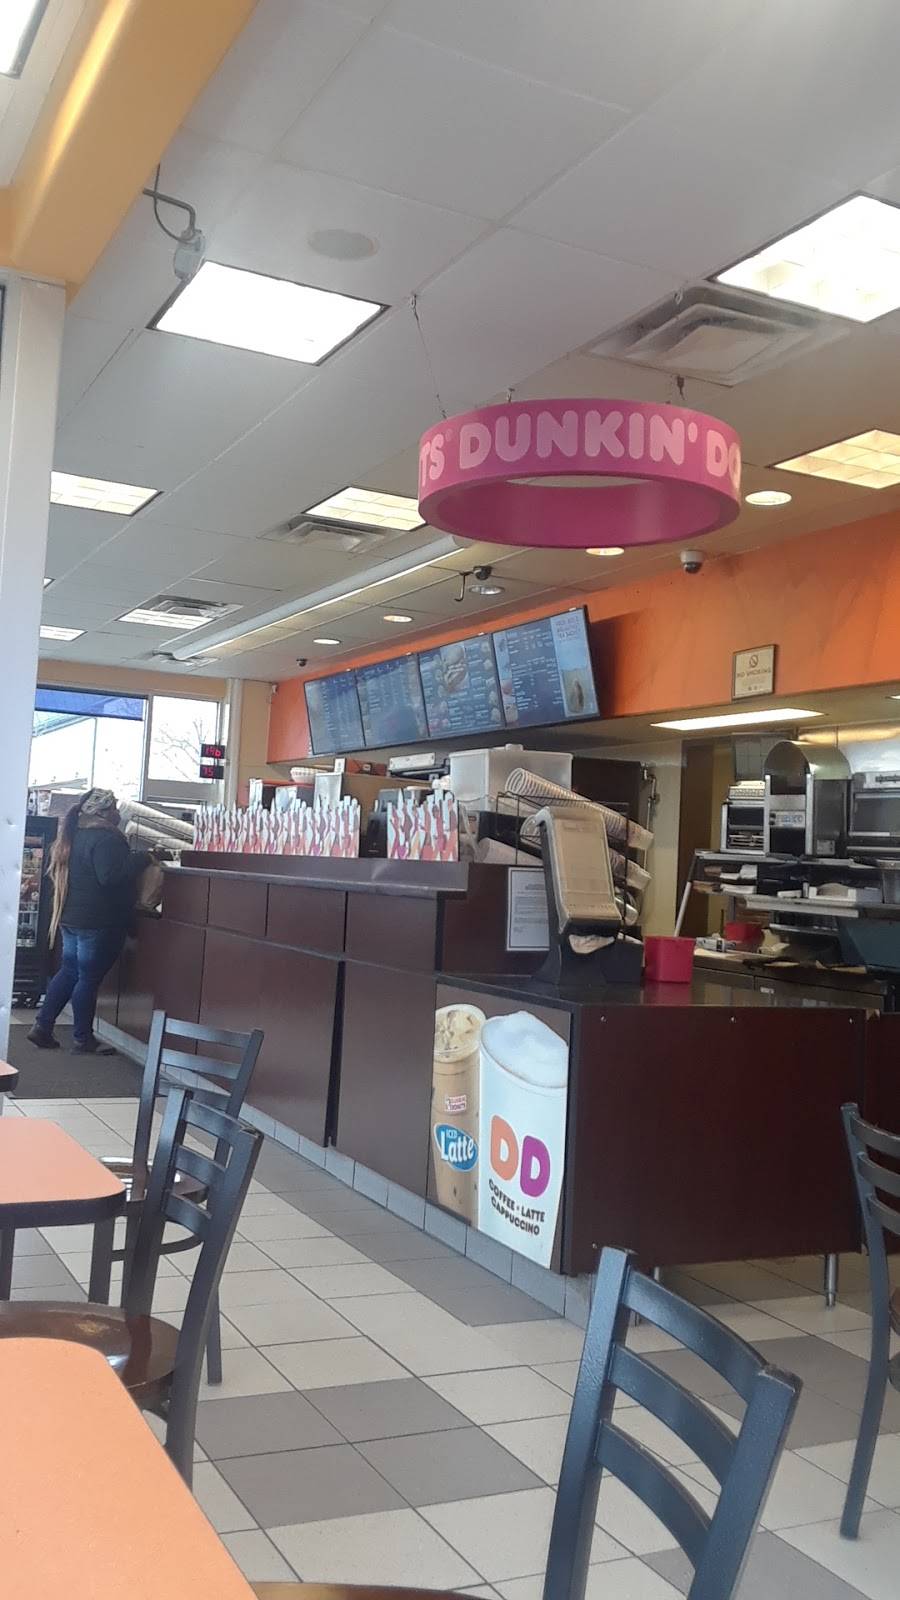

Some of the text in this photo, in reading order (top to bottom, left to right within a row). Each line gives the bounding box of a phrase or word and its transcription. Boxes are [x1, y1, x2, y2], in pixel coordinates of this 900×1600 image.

[459, 409, 699, 469] DUNKIN'
[441, 1130, 474, 1163] Latte
[488, 1178, 546, 1223] COFFEE LATTE
[490, 1195, 541, 1237] CAPPUCCINO
